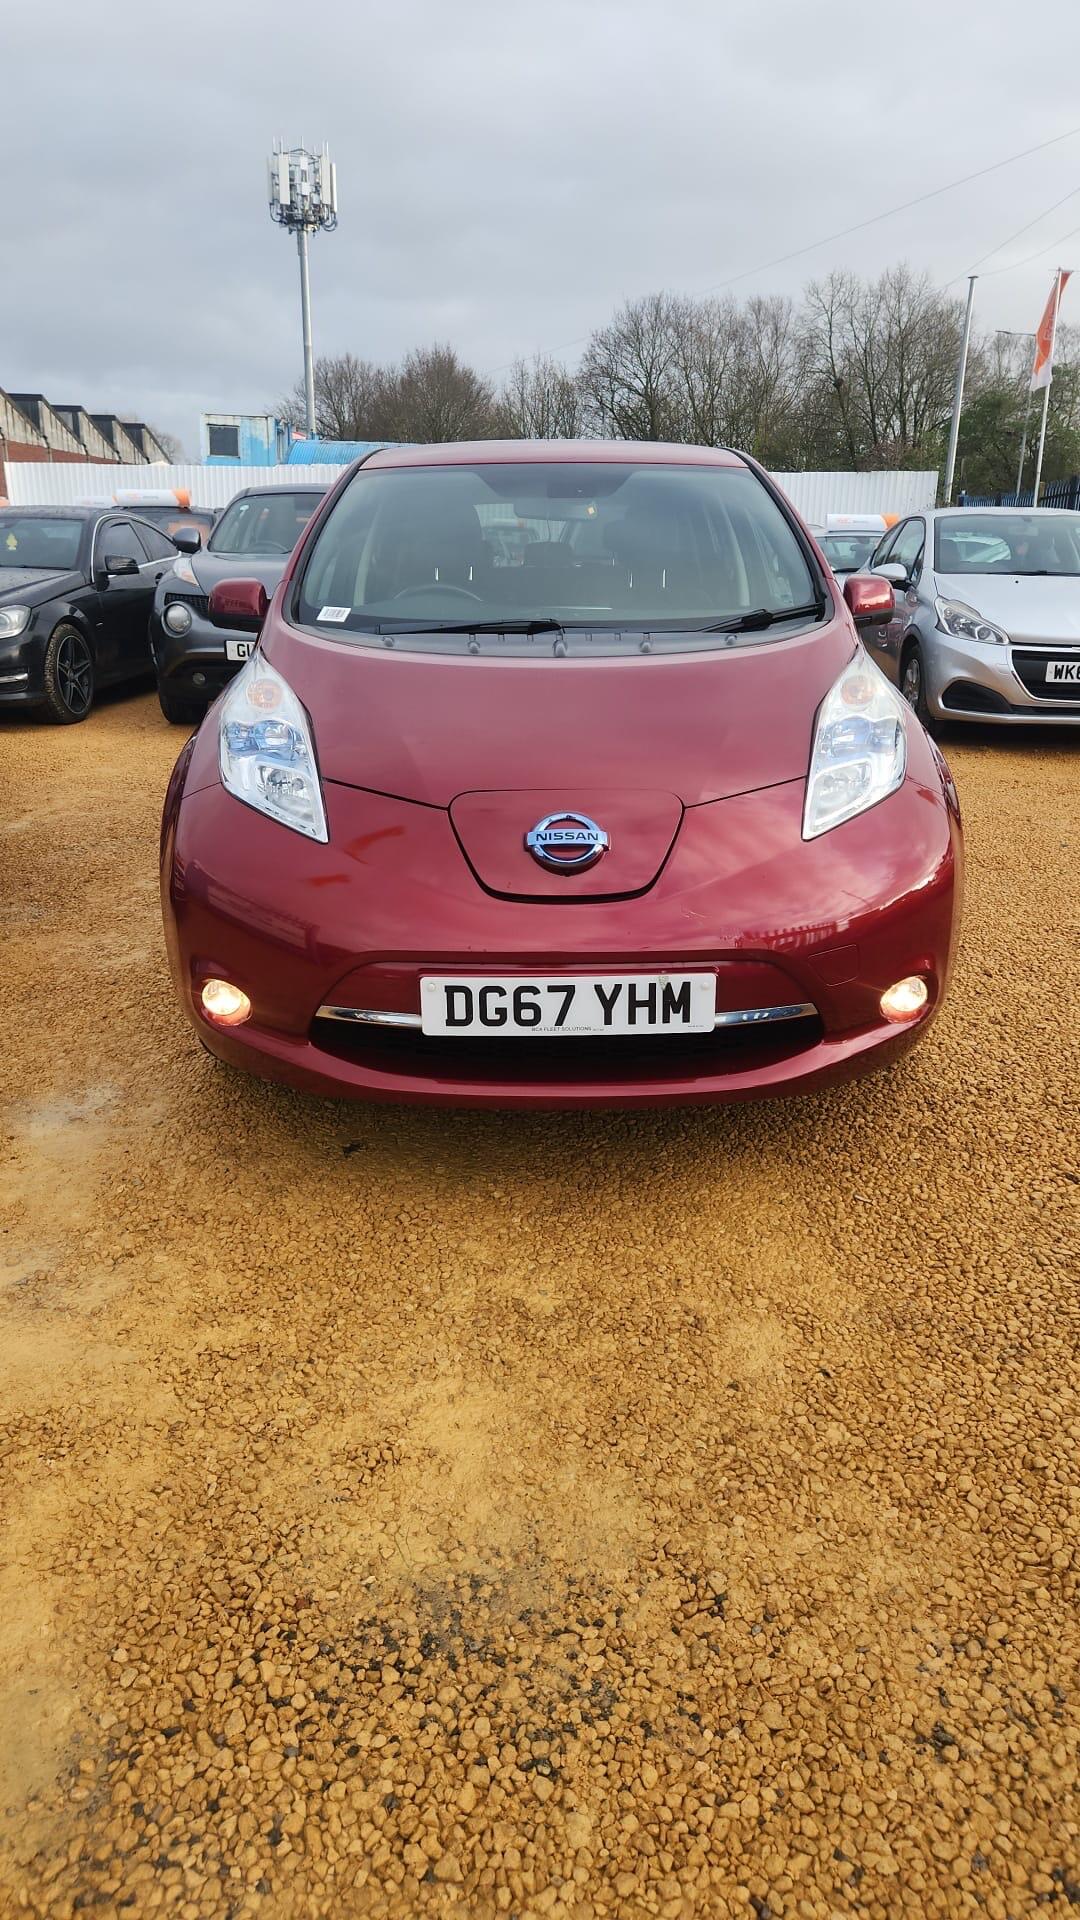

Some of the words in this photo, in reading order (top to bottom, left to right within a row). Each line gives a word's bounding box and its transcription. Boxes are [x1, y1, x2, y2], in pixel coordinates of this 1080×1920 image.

[536, 832, 599, 841] NISSAN
[445, 985, 576, 1027] DG67
[594, 981, 691, 1026] YHM
